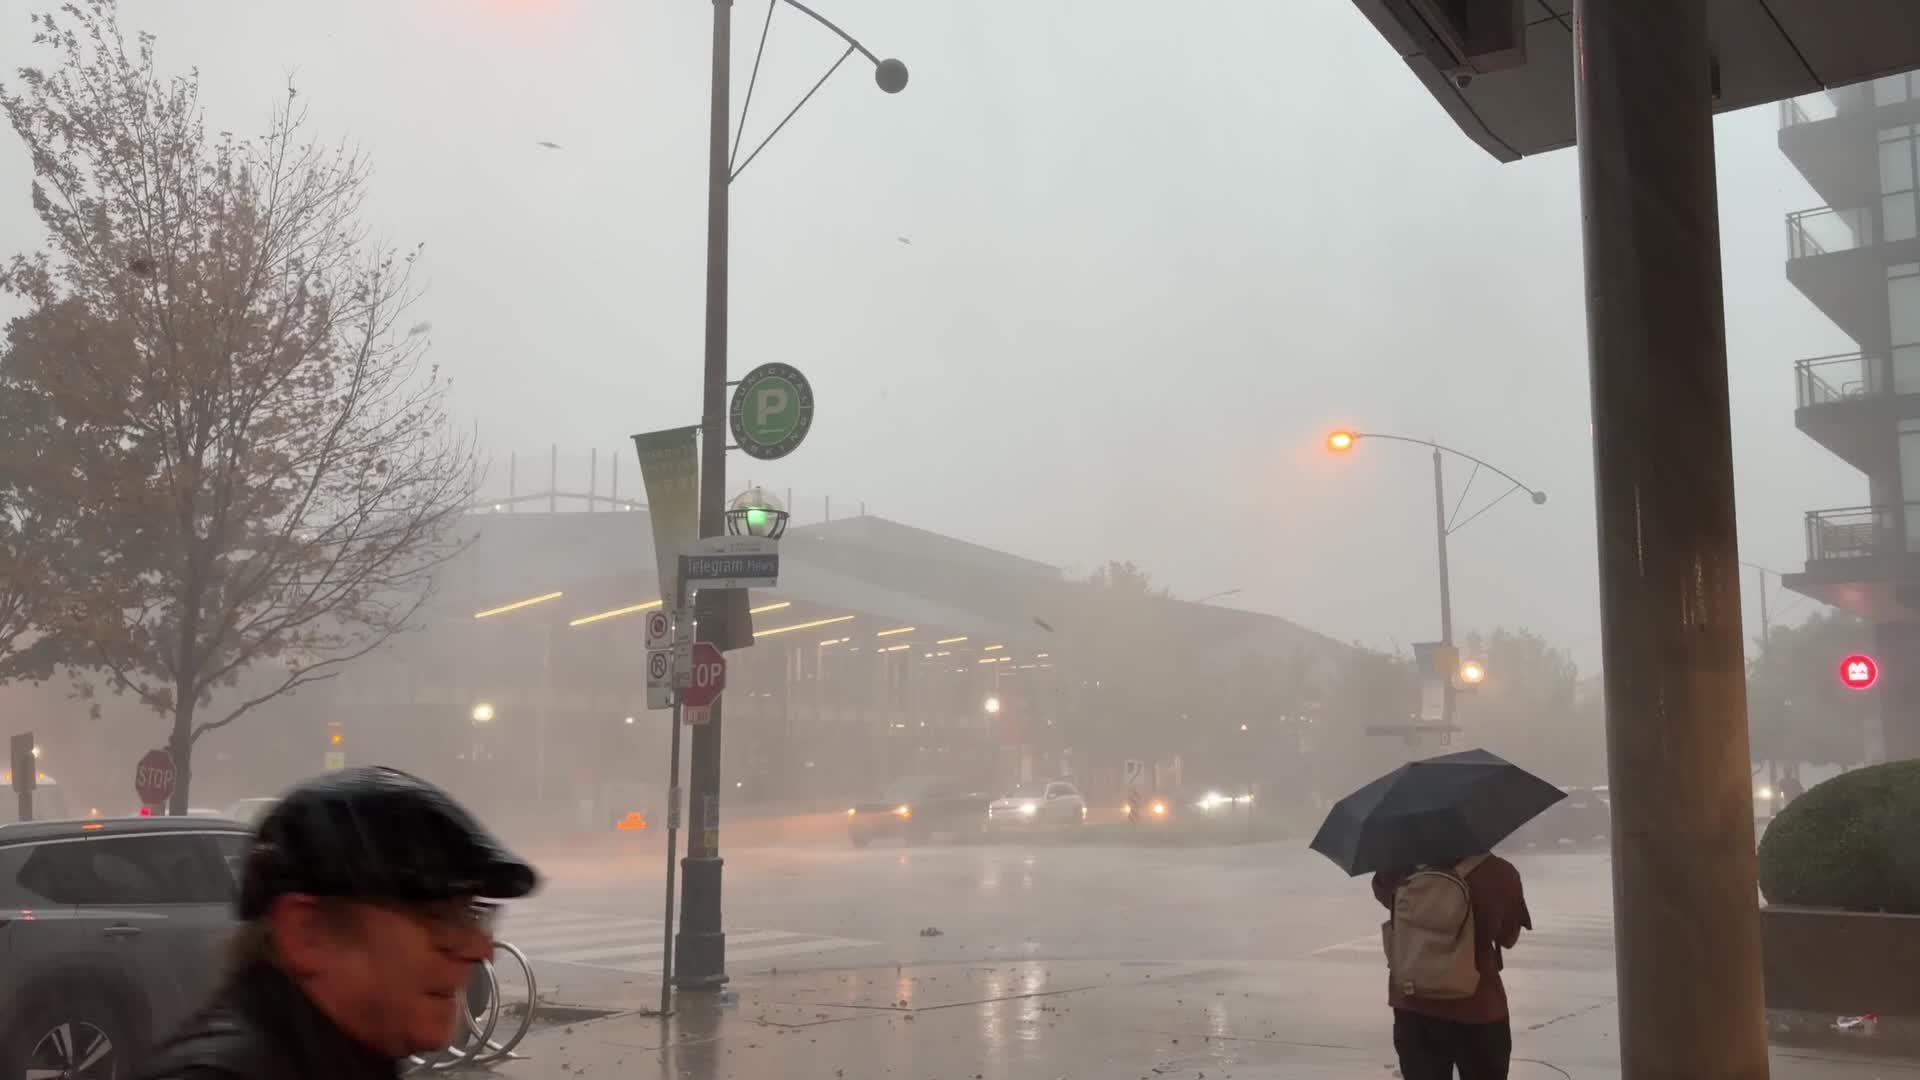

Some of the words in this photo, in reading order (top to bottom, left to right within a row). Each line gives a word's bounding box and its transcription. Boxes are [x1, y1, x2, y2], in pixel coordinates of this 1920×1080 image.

[757, 388, 787, 426] P
[688, 560, 743, 577] Telegram
[138, 768, 173, 789] STOP
